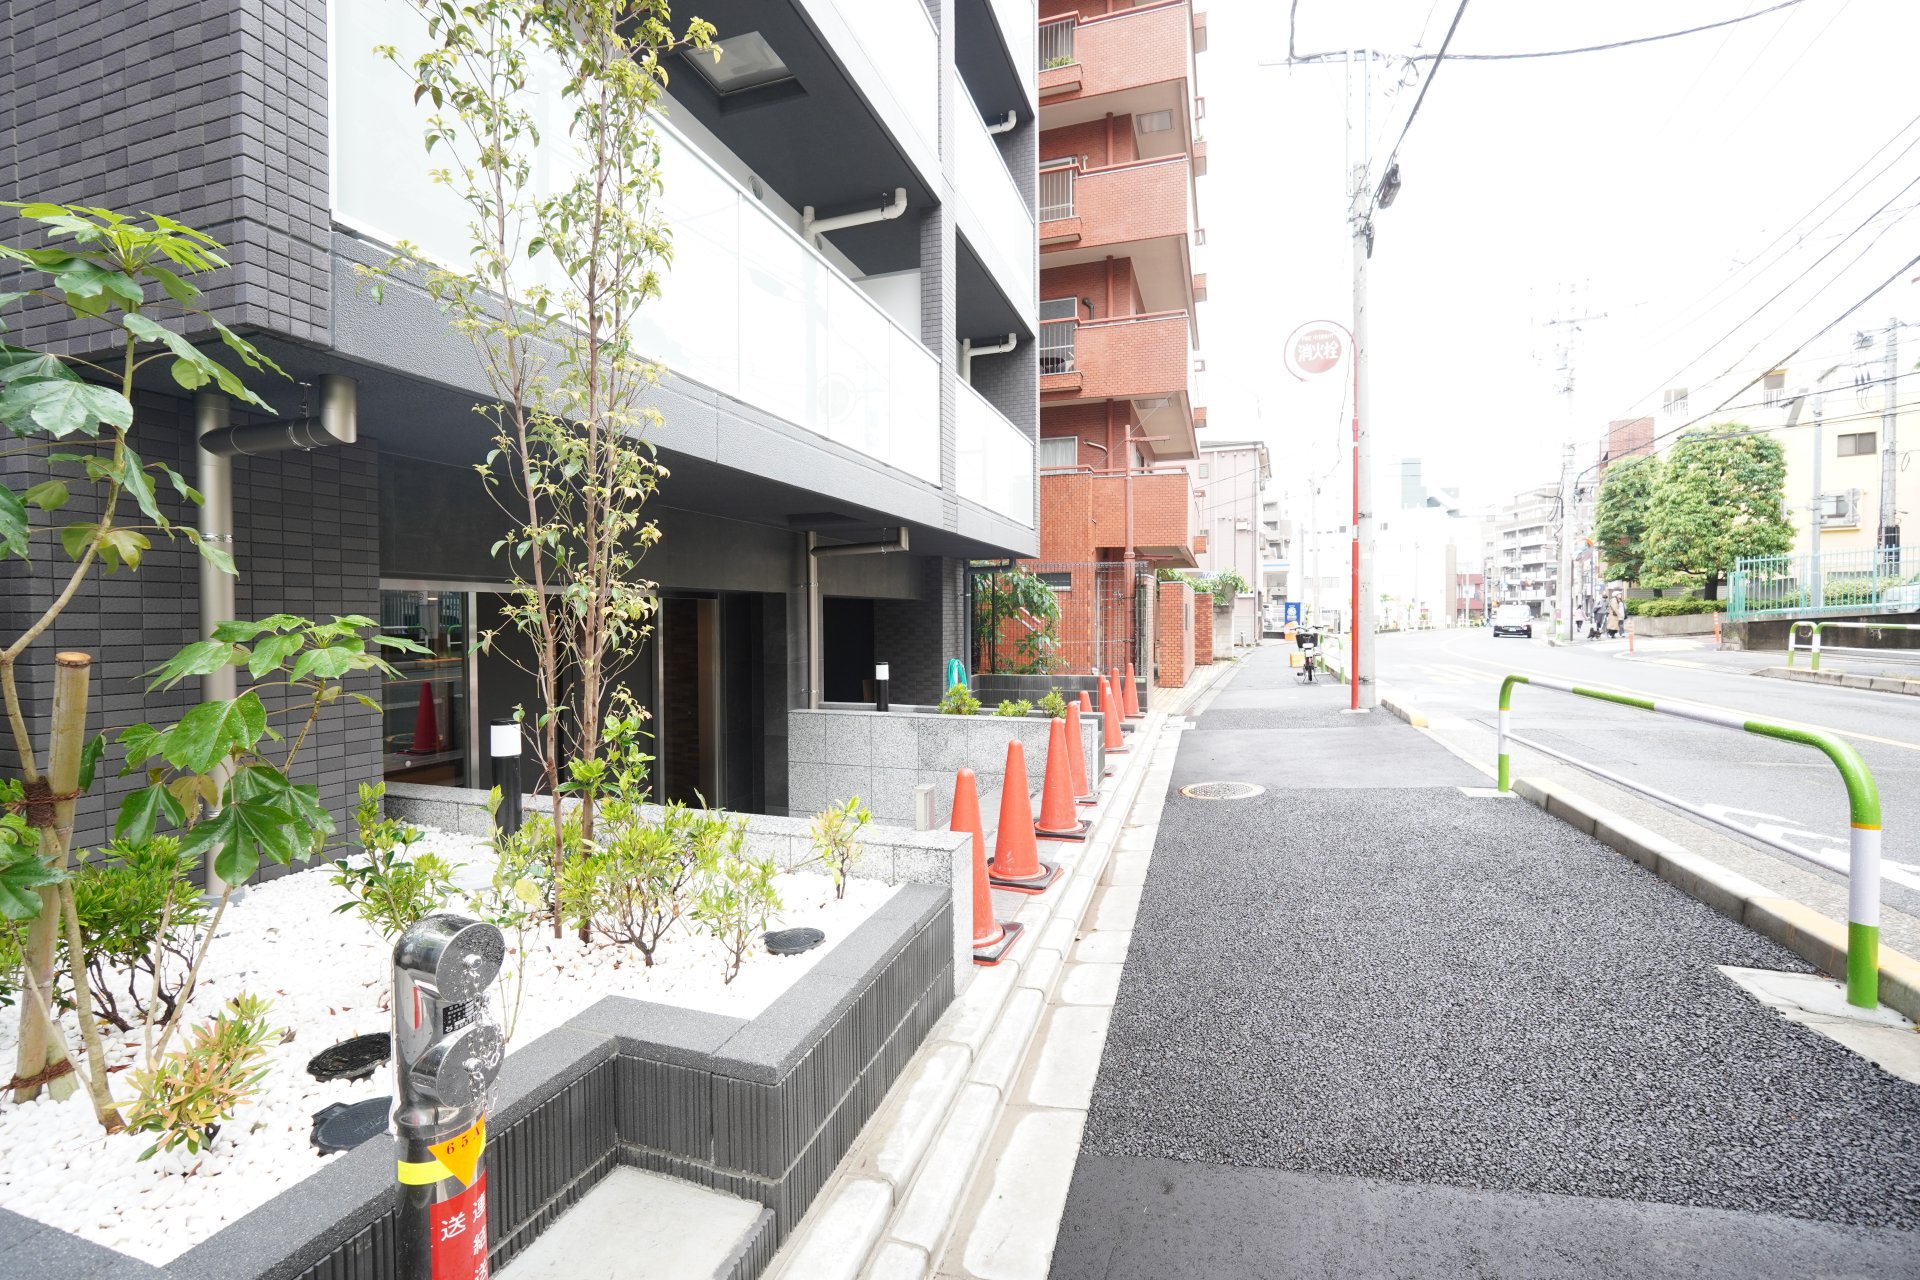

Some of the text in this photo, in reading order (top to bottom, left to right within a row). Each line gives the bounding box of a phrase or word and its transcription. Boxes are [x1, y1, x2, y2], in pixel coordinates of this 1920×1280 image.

[1298, 341, 1339, 362] 消火栓
[441, 1211, 466, 1242] 送
